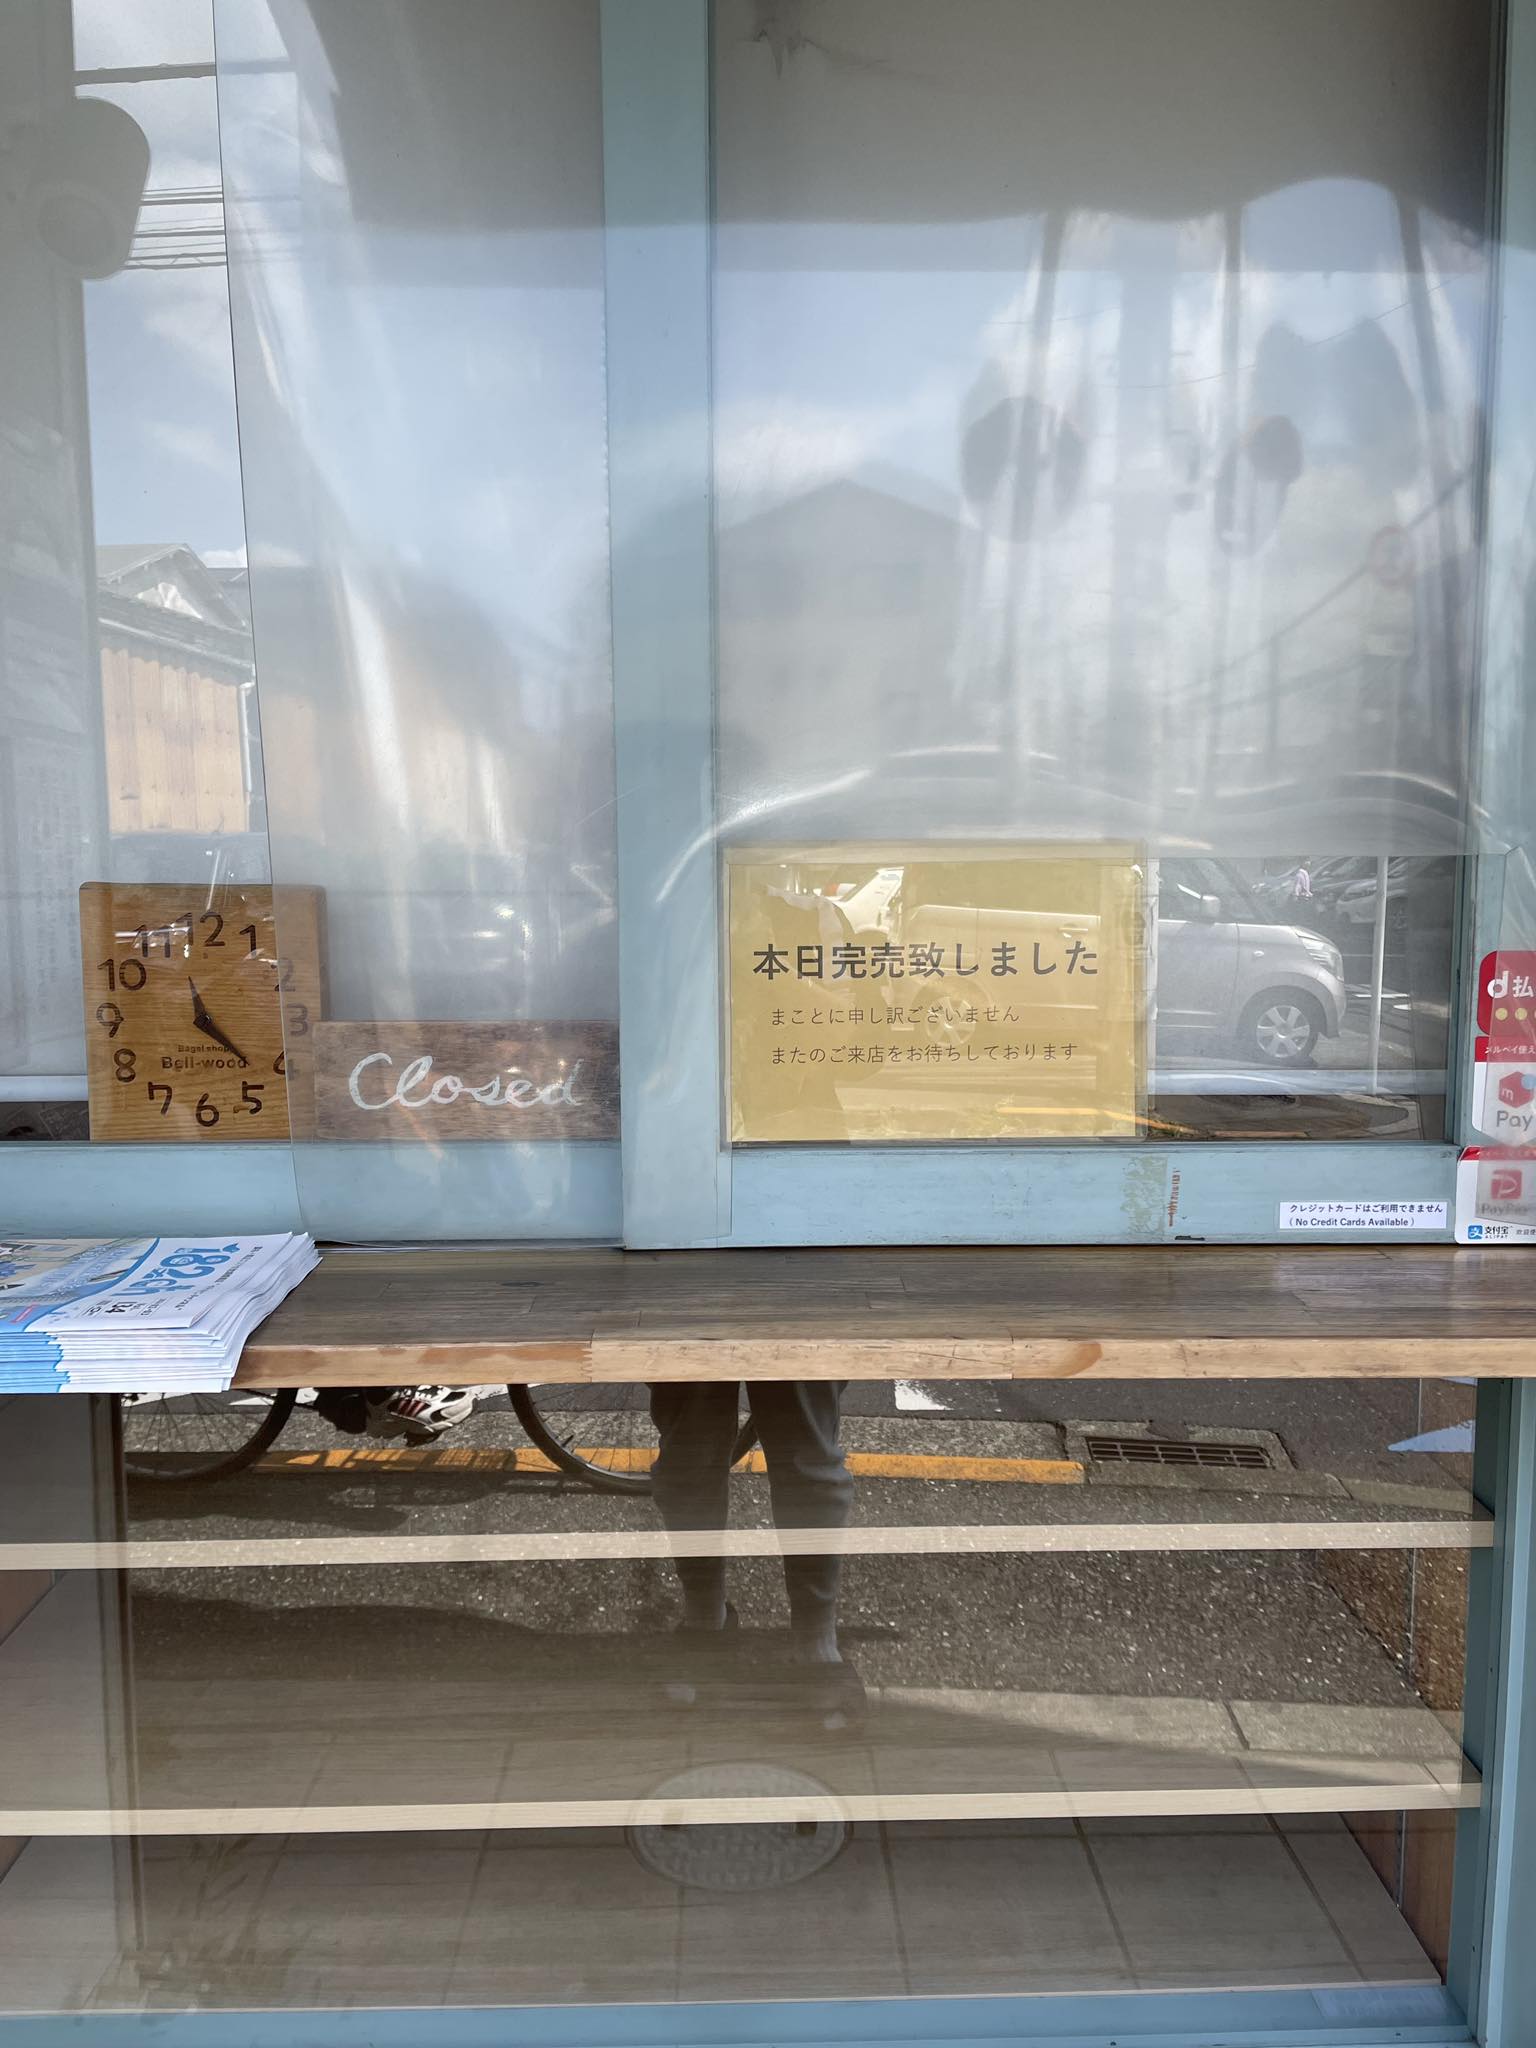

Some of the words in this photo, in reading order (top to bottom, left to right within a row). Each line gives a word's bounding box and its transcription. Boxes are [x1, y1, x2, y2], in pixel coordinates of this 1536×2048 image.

[174, 911, 226, 948] 12
[239, 924, 257, 952] 1
[97, 958, 148, 992] 10
[752, 941, 1099, 981] 本日完売致しました
[96, 1002, 125, 1038] 9
[287, 1003, 309, 1036] 3
[771, 1006, 1021, 1026] まことに申し訳ございません
[113, 1048, 137, 1083] 8
[161, 1056, 248, 1069] Bell-wood
[771, 1043, 1079, 1065] またのご来店をお待ちしております
[241, 1080, 265, 1115] 5
[349, 1052, 586, 1110] Closed
[147, 1081, 173, 1116] 7
[195, 1093, 220, 1127] 6
[1496, 1110, 1533, 1132] Pay
[1290, 1203, 1444, 1213] クレジットカードはご利用できません
[1295, 1218, 1308, 1226] No
[1310, 1217, 1338, 1227] Credit
[1340, 1217, 1366, 1227] Cards
[1368, 1217, 1409, 1227] Available
